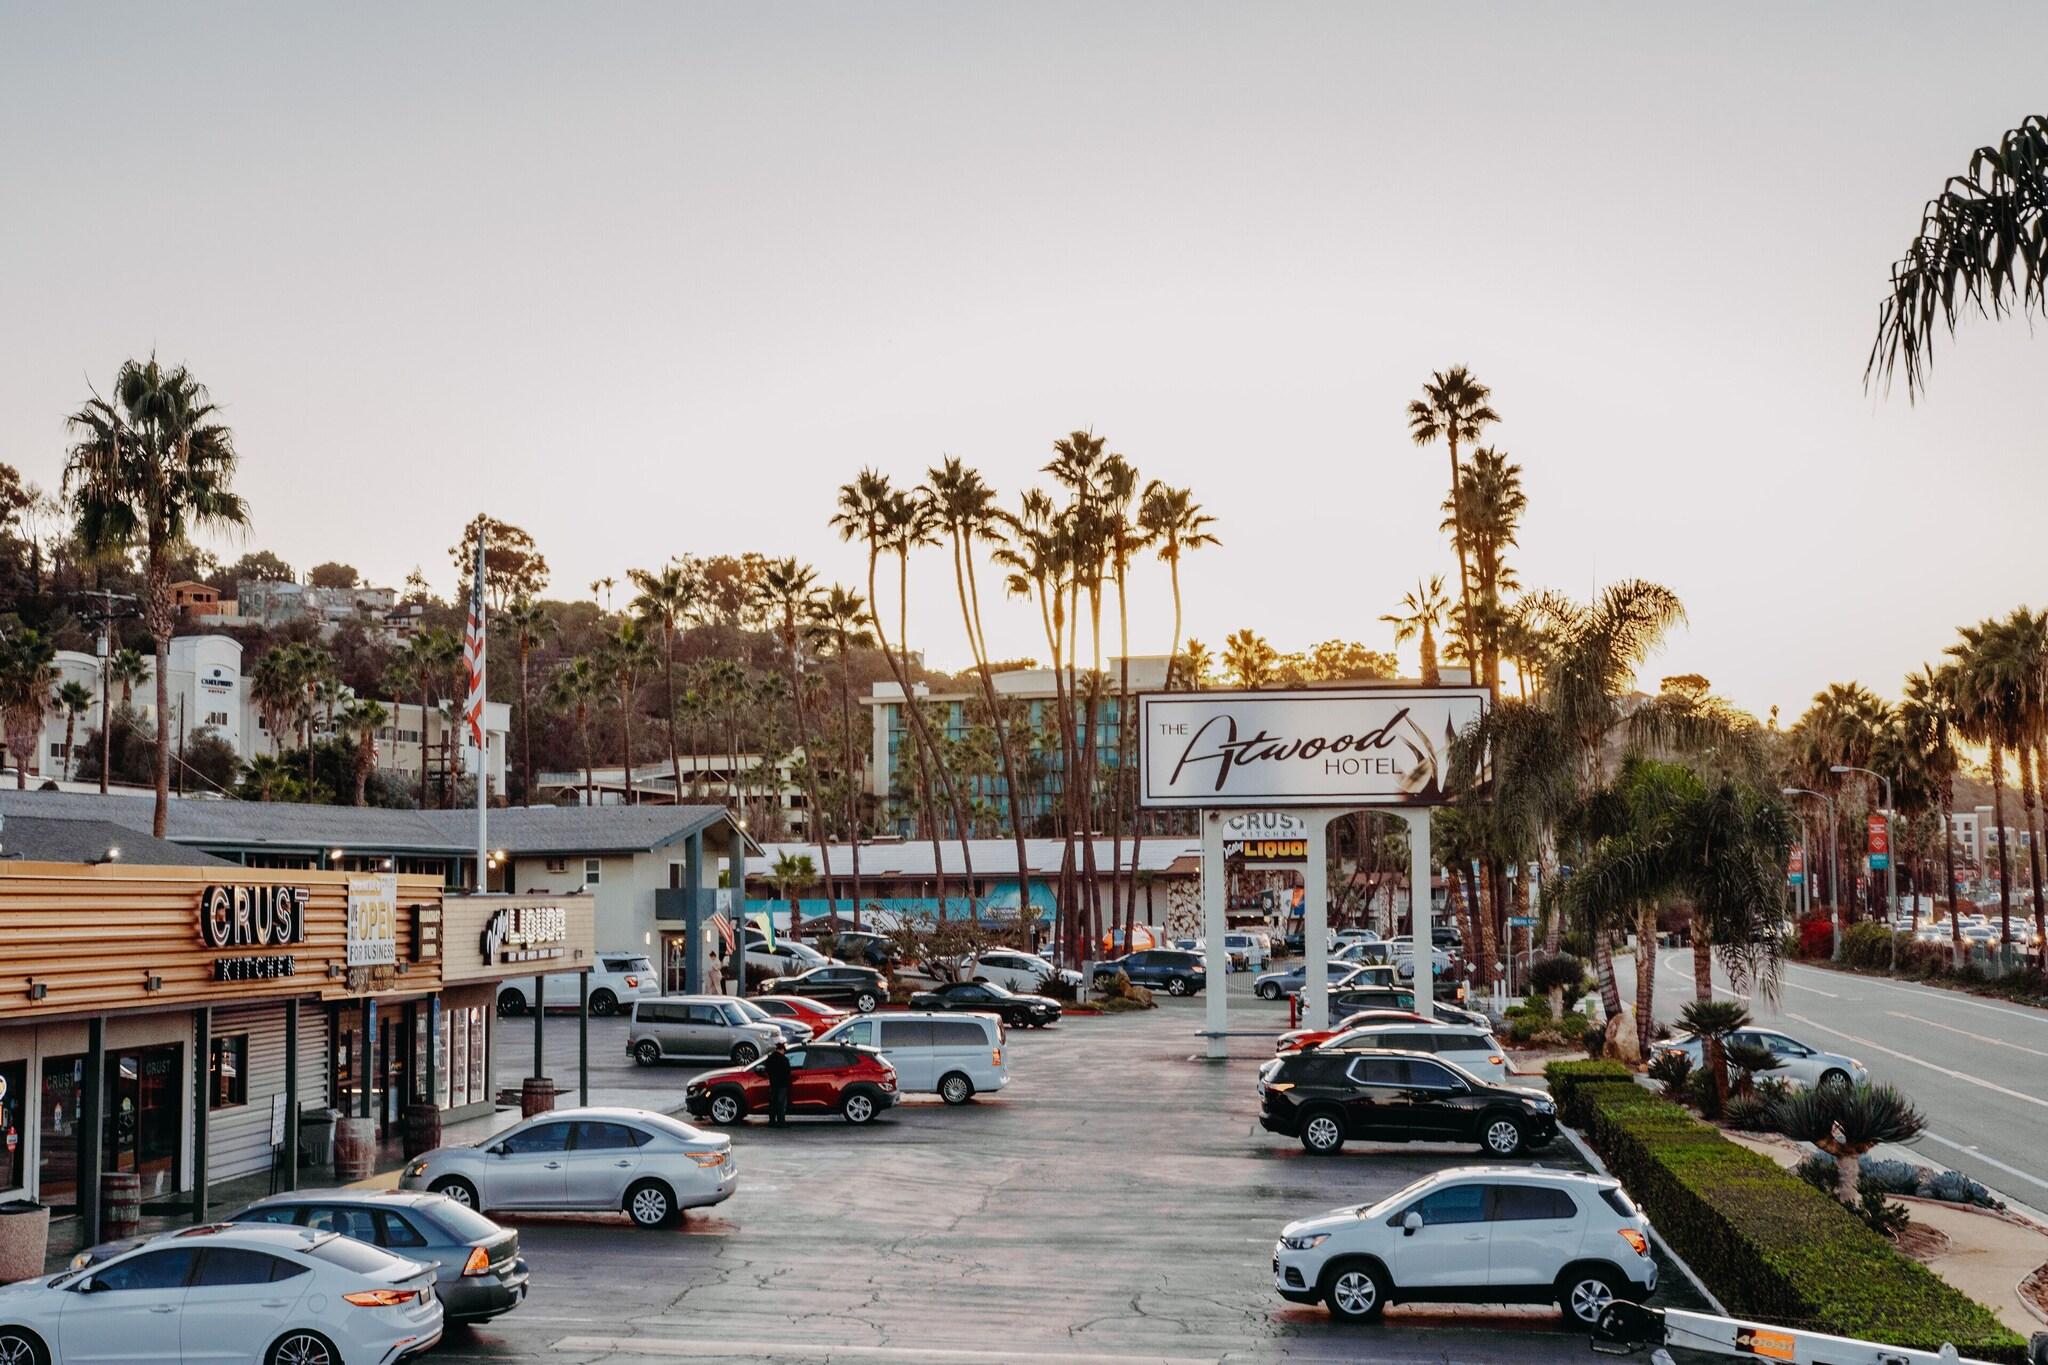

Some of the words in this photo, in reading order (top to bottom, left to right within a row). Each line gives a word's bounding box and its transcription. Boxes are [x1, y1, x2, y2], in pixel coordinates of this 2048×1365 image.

[1160, 723, 1189, 736] THE
[1168, 707, 1410, 792] Atwood
[1325, 758, 1403, 776] HOTEL
[1241, 830, 1297, 838] KITCHEN
[204, 886, 309, 946] CRUST
[358, 901, 395, 941] OPEN
[509, 907, 566, 949] LIQUOR
[349, 944, 363, 961] FOR
[364, 942, 394, 960] BUSINESS
[221, 955, 295, 981] KITCHEN
